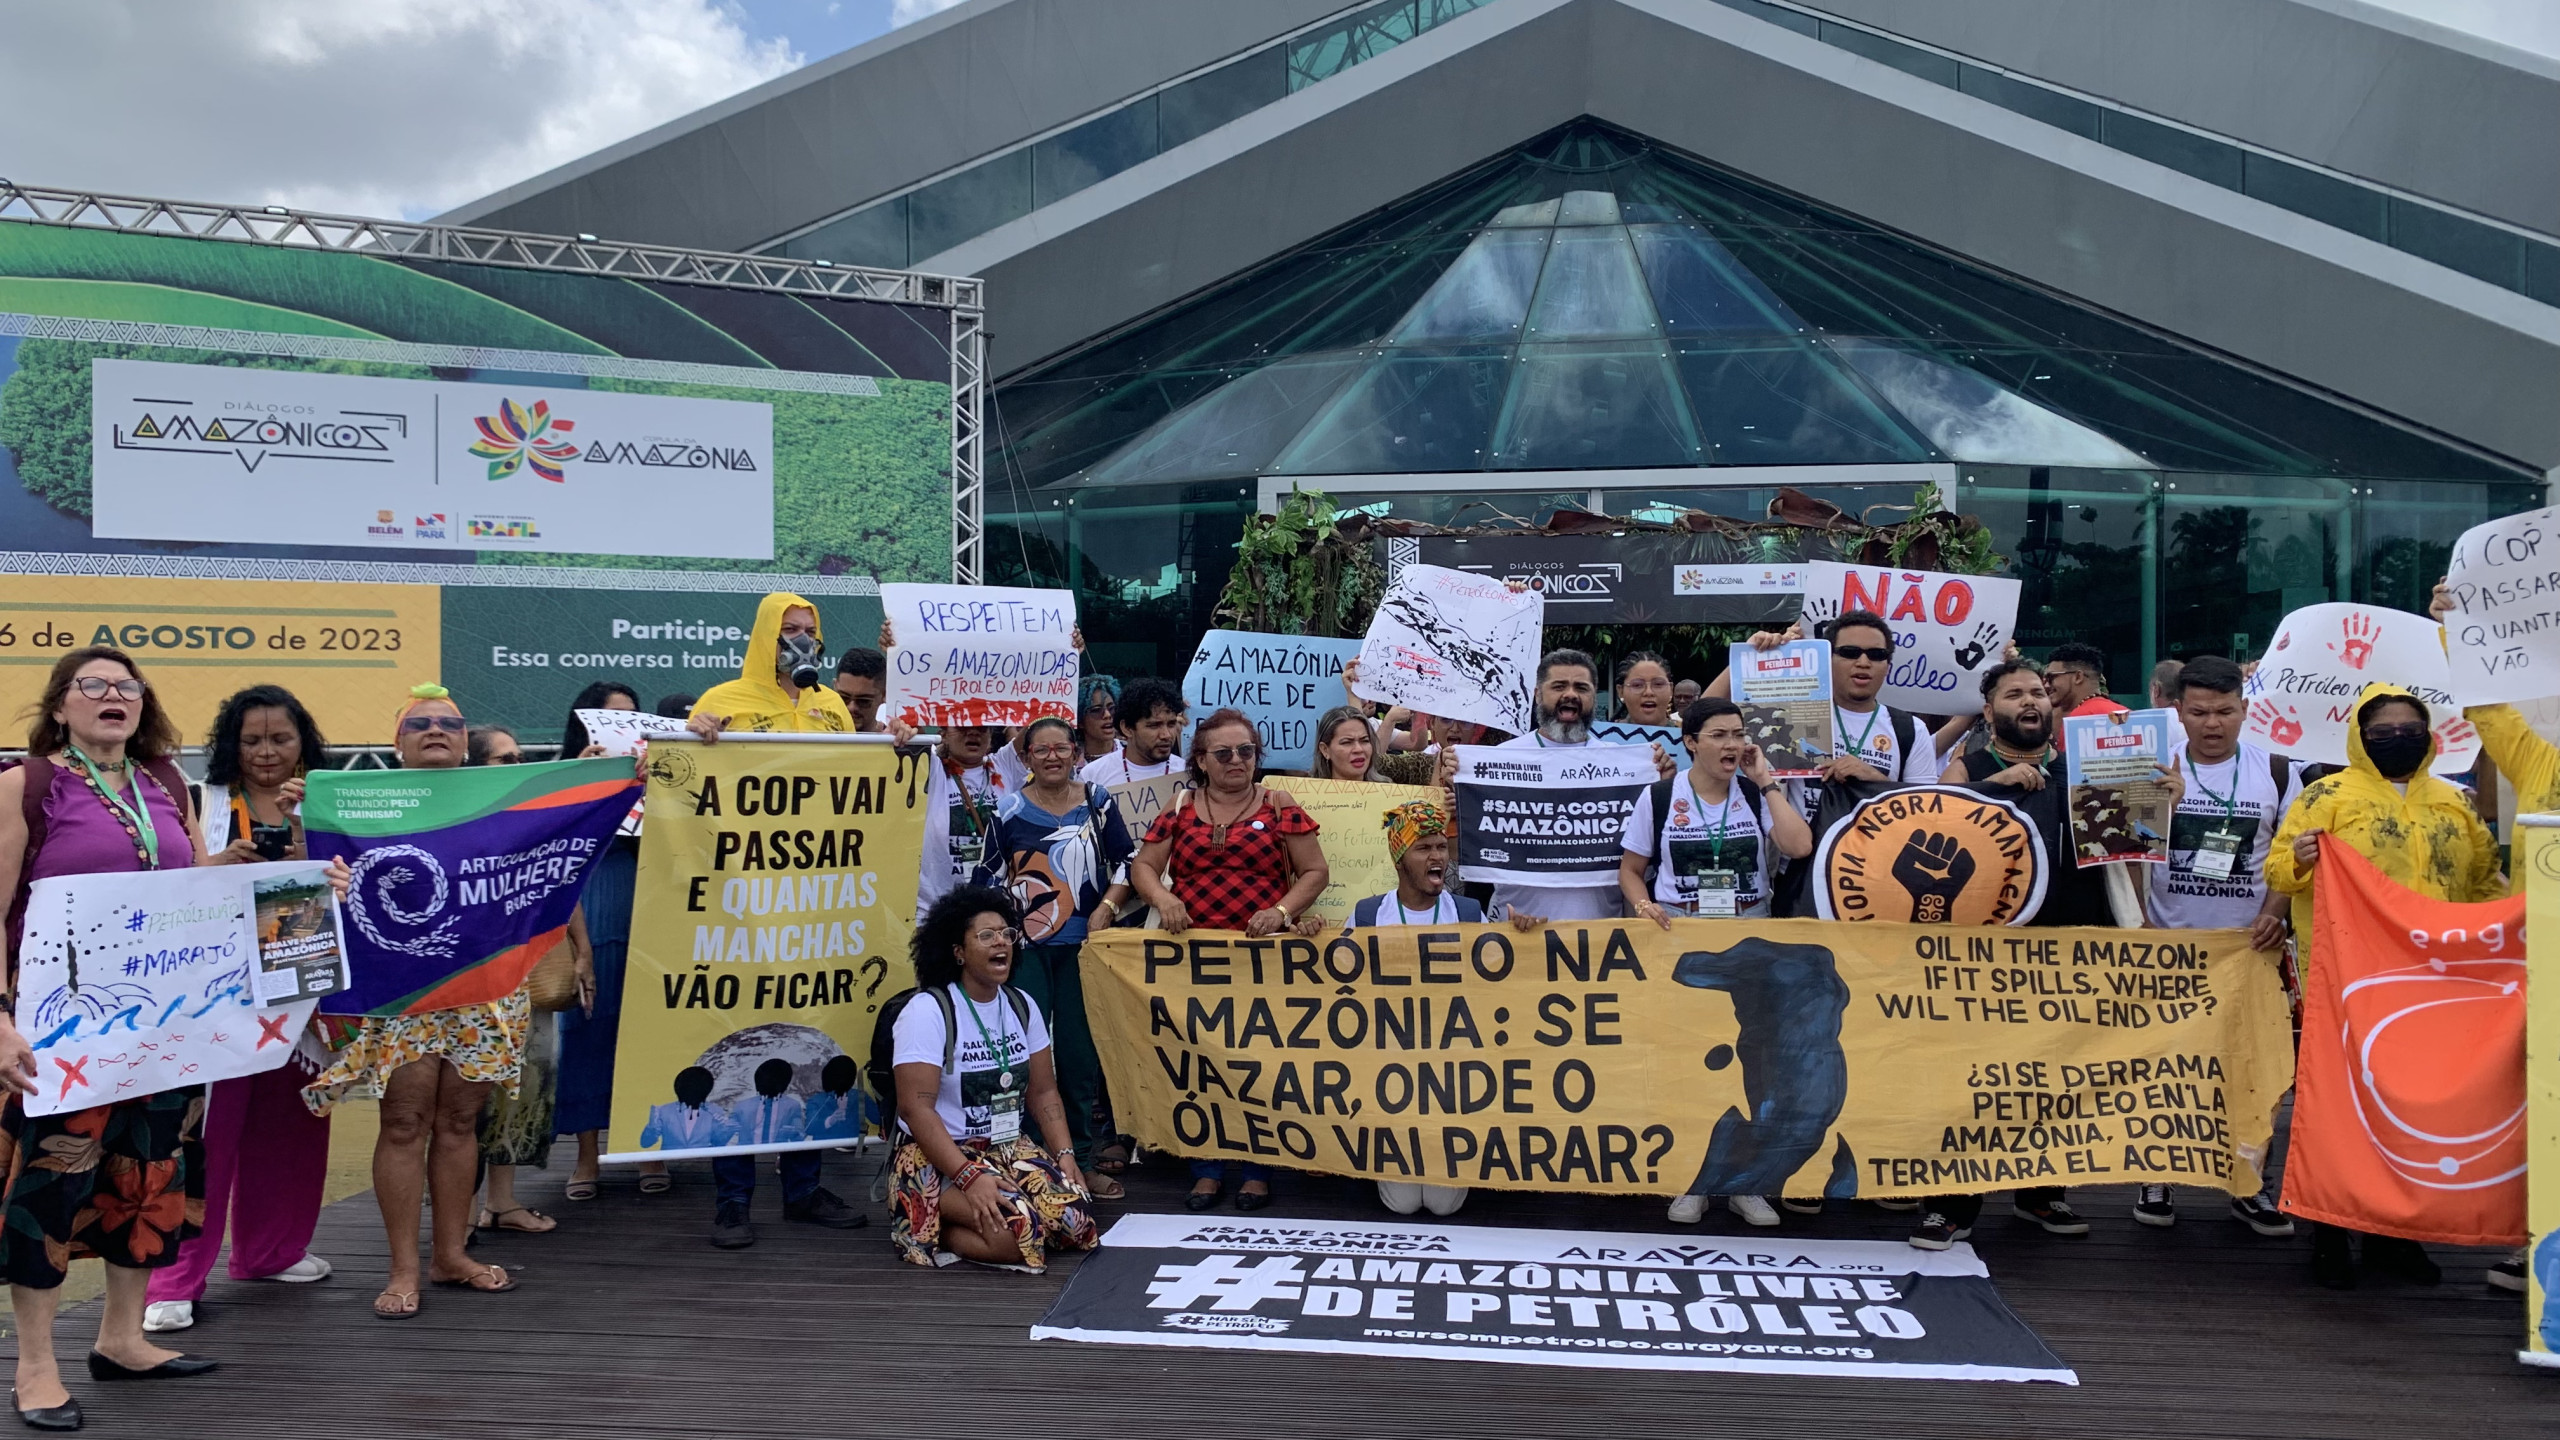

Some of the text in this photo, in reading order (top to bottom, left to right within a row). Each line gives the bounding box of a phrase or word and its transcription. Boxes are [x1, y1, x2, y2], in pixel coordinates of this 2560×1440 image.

[224, 401, 315, 415] DIÁLOGOS
[584, 440, 756, 471] AMAZÔNIA
[1510, 562, 1564, 570] DIÁLOGOS
[2452, 528, 2542, 571] A COP
[1841, 571, 1974, 626] NÃO
[612, 619, 750, 645] Participe.
[919, 600, 1063, 633] RESPEITEM
[32, 622, 74, 647] de
[90, 624, 256, 649] AGOSTO
[268, 626, 307, 650] de
[320, 628, 401, 651] 2023
[493, 646, 743, 668] Essa conversa tamb
[897, 651, 932, 675] OS
[945, 648, 1078, 680] AMAZONIDAS
[1215, 644, 1345, 677] AMAZÔNIA
[1047, 677, 1073, 696] NÃO
[1201, 678, 1316, 709] LIVRE DE
[2132, 725, 2157, 755] AO
[334, 788, 432, 797] TRANSFORMANDO
[336, 799, 420, 808] O MUNDO PELO
[695, 776, 887, 816] A COP VAI
[1483, 800, 1554, 815] #SALVE
[1567, 800, 1634, 815] COSTA
[2241, 801, 2260, 809] FREE
[338, 810, 402, 819] FEMINISMO
[1857, 794, 1943, 840] NEGRA
[570, 838, 598, 854] DE
[714, 829, 864, 871] PASSAR
[687, 872, 878, 920] E QUANTAS
[2168, 884, 2255, 898] AMAZÔNICA
[264, 939, 336, 960] AMAZÔNICA
[692, 920, 866, 963] MANCHAS
[1144, 928, 1646, 985] PETRÓLEO NA
[1915, 935, 2208, 970] OIL IN THE AMAZON:
[663, 964, 740, 1010] VÃO
[1924, 966, 2209, 1000] IF IT SPILLS, WHERE
[1533, 993, 1622, 1047] SE
[1875, 993, 2218, 1029] WIL THE OIL END UP?
[1155, 1046, 1596, 1119] VAZAR, ONDE O
[1967, 1054, 2225, 1089] ¿SI SE DERRAMA
[1973, 1088, 2137, 1121] PETRÓLEO
[1172, 1091, 1675, 1183] ÓLEO VAI PARAR?
[1941, 1113, 2231, 1152] AMAZÔNIA, DONDE
[1869, 1151, 2057, 1186] TERMINARÁ
[2066, 1149, 2111, 1174] EL
[1181, 1233, 1452, 1253] AMAZÔNICA
[1199, 1226, 1316, 1238] #SALVE
[1334, 1231, 1451, 1243] COSTA
[1311, 1257, 1682, 1296] AMAZÔNIA
[1698, 1273, 1903, 1301] LIVRE
[1301, 1285, 1927, 1340] DE PETRÓLEO
[1364, 1328, 1874, 1359] marsempetroleo.arayara.org
